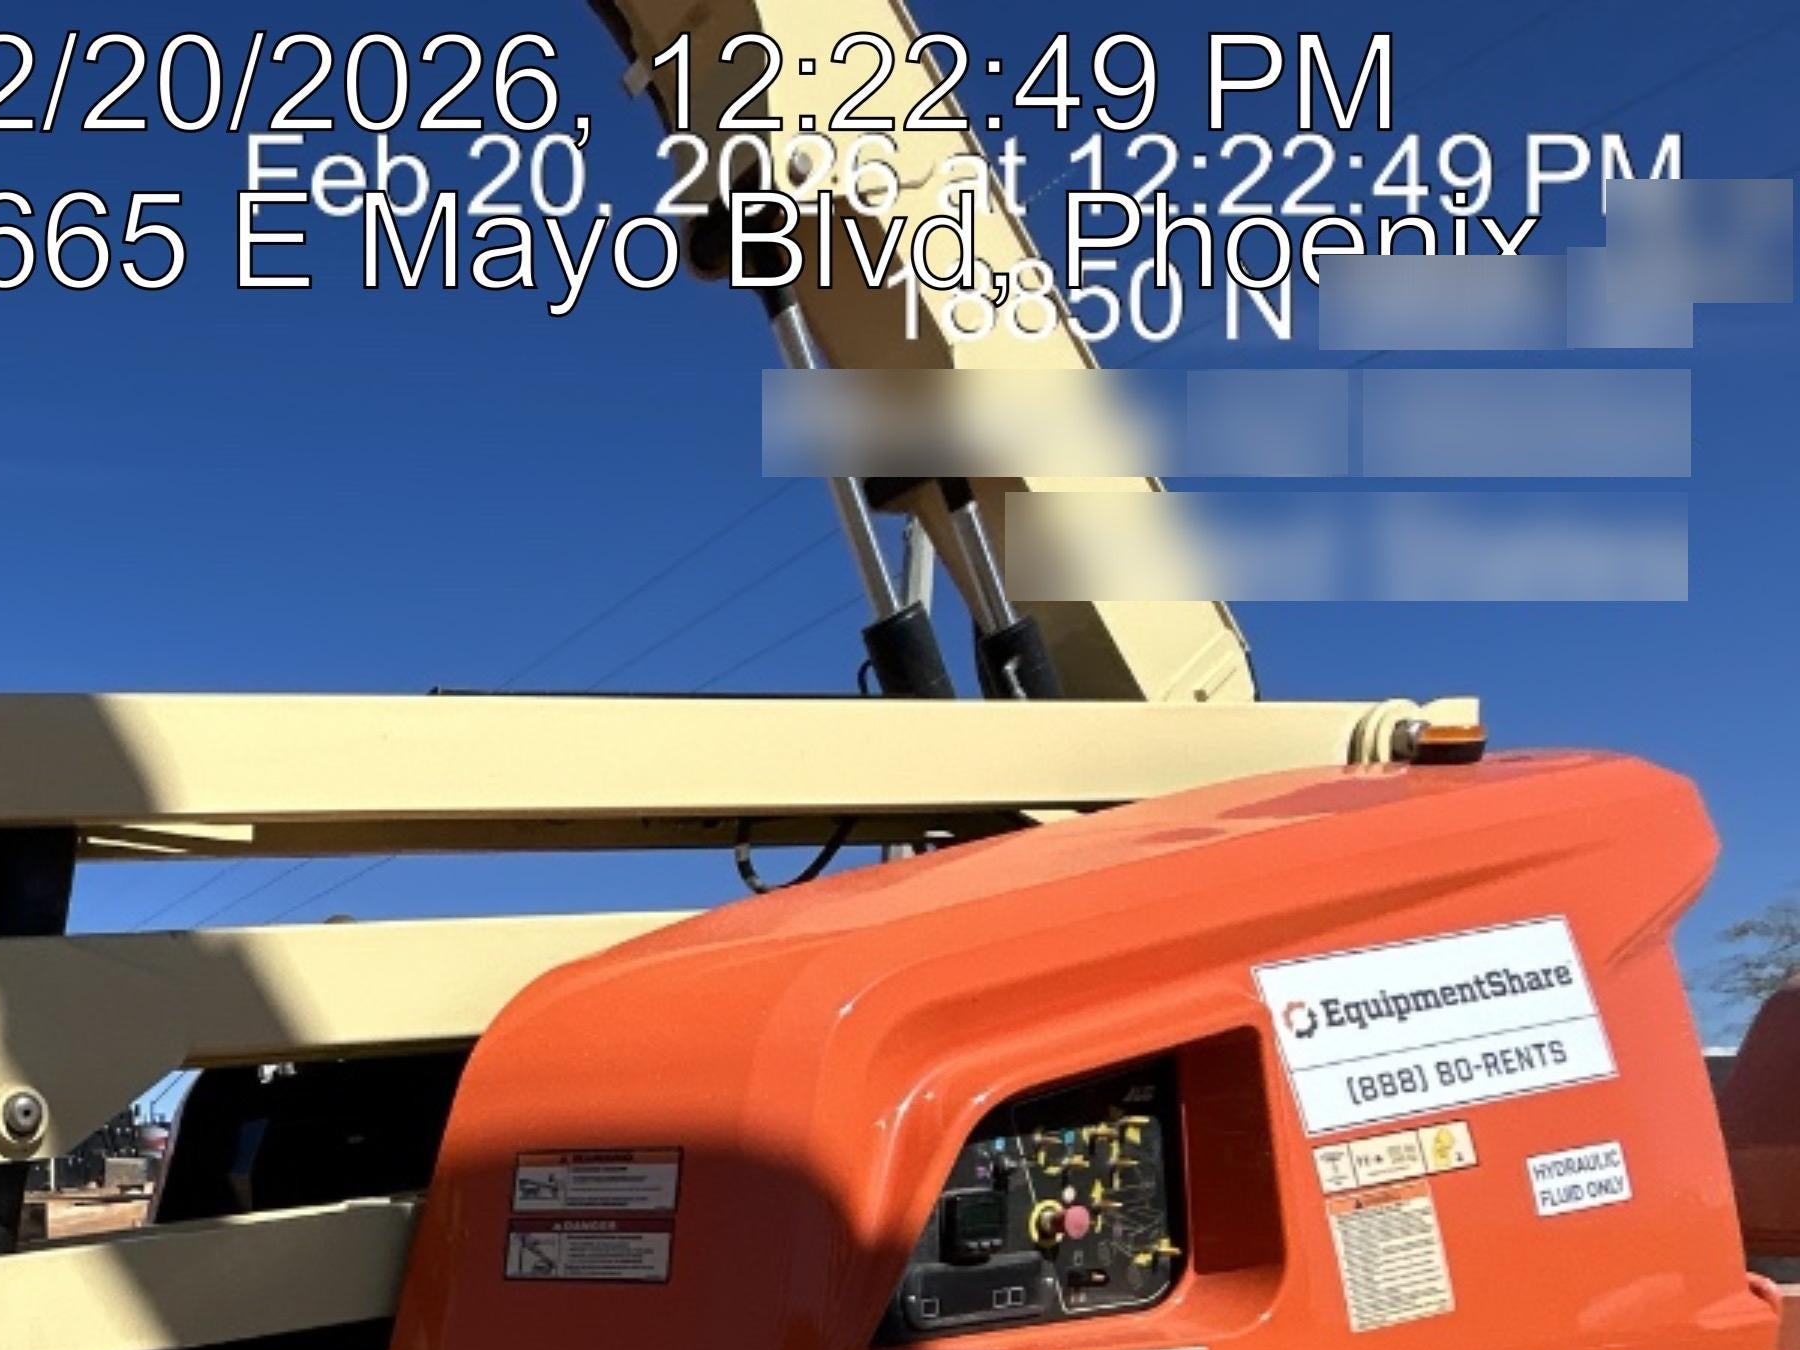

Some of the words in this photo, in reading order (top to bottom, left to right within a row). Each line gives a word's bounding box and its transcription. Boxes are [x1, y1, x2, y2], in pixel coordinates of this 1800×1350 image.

[1319, 963, 1574, 1030] EquipmentShare
[1346, 1065, 1430, 1105] (888)
[1435, 1039, 1568, 1086] 80-RENTS
[1533, 1148, 1621, 1183] HYDRAULIC
[1540, 1183, 1585, 1207] FLUID
[1587, 1176, 1624, 1198] ONLY
